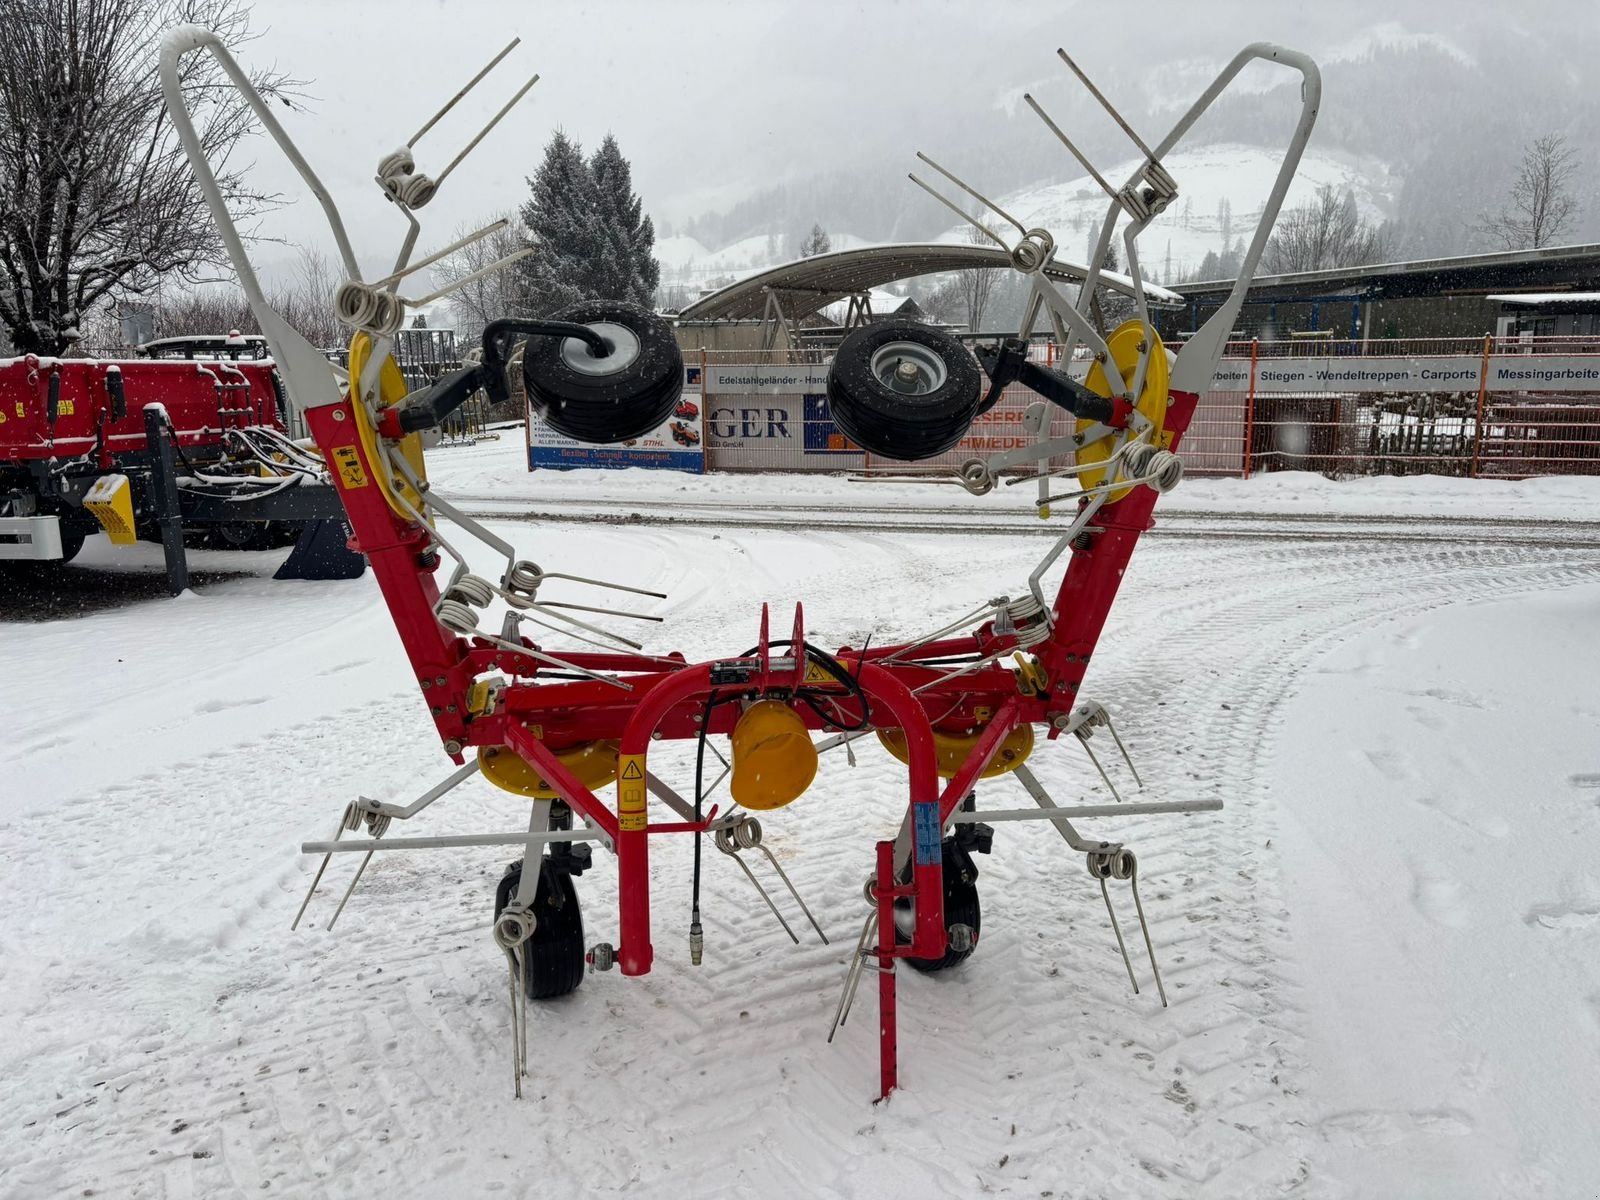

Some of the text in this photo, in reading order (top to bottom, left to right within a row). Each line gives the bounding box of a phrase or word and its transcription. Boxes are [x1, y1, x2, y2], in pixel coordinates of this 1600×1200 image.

[1260, 371, 1305, 382] Stiegen
[1316, 370, 1409, 382] Wendeltreppen
[1421, 369, 1477, 382] Carports
[1497, 368, 1600, 381] Messingarbeite
[719, 376, 798, 387] Edelstahlgeländer
[709, 408, 792, 438] GER
